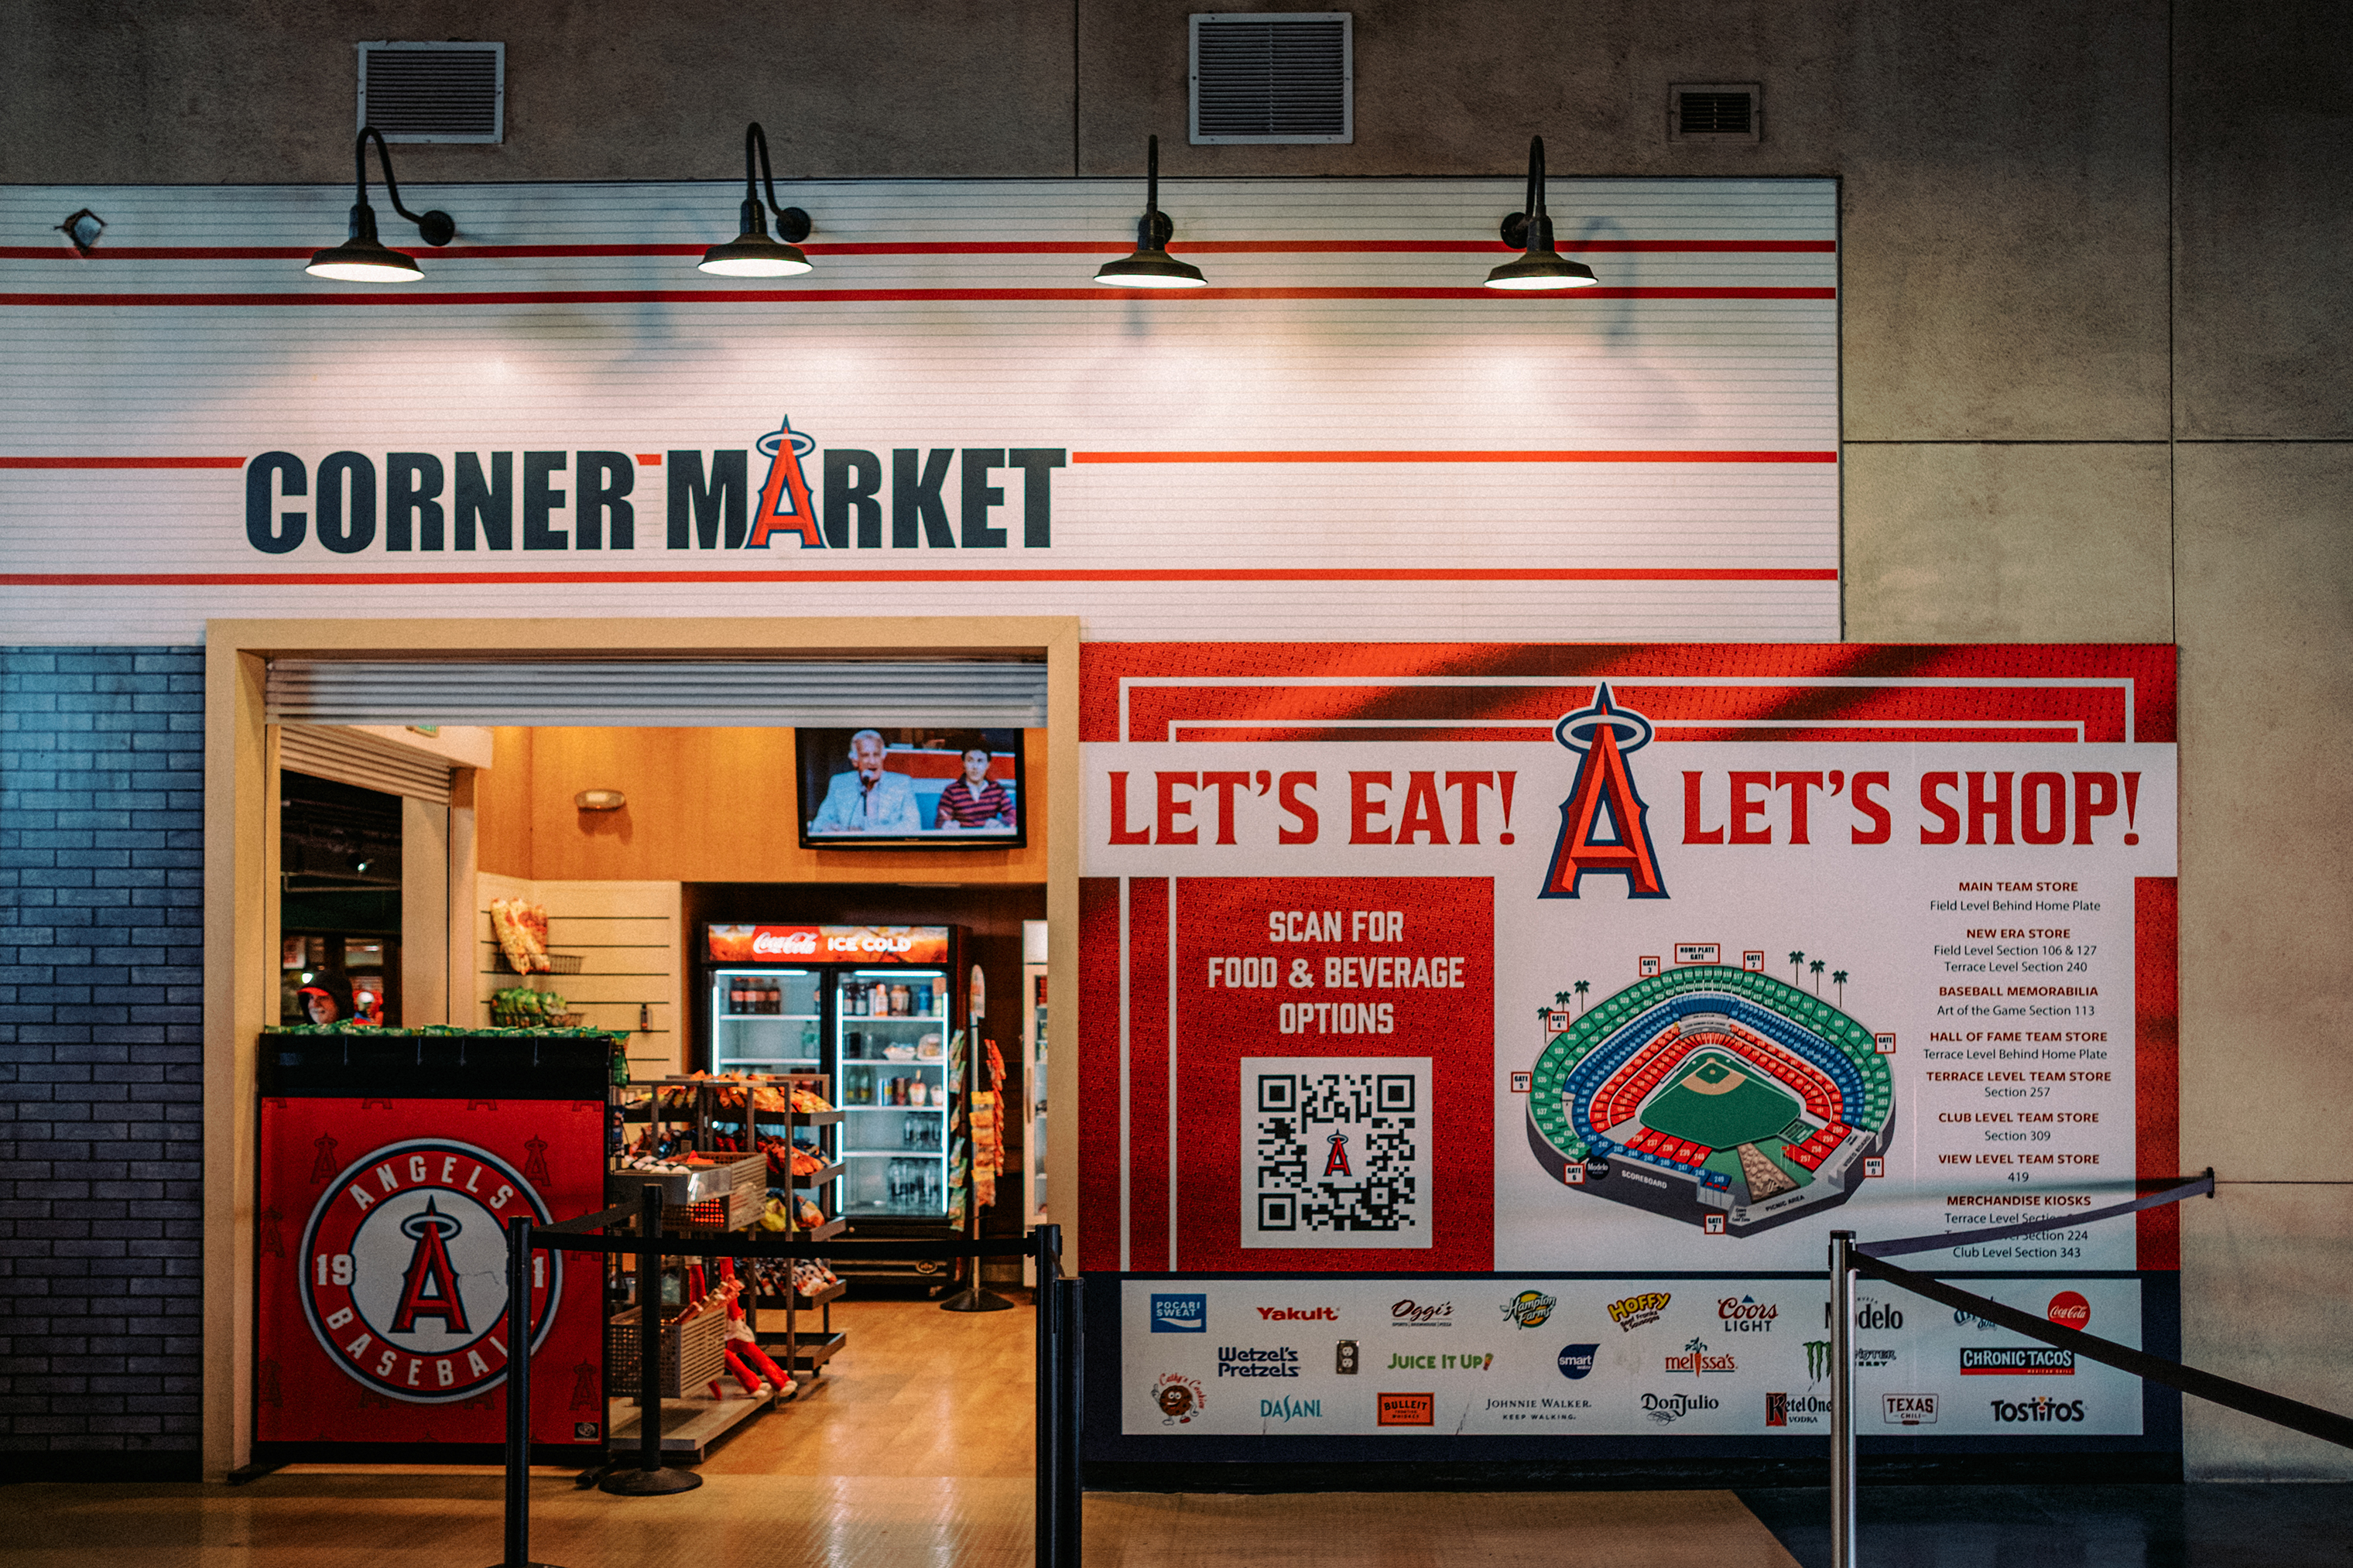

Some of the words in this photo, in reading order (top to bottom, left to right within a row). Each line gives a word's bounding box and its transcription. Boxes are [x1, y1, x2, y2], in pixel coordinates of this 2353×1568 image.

[245, 450, 635, 554] CORNER
[666, 414, 1067, 549] MARKET
[1537, 681, 1670, 899] A
[1108, 769, 1320, 846] LET'S
[1348, 769, 1518, 846] EAT!
[1681, 769, 1892, 845] LET'S
[1920, 770, 2142, 847] SHOP!
[1959, 882, 1993, 892] MAIN
[1997, 882, 2033, 892] TEAM
[2036, 882, 2078, 892] STORE
[1930, 900, 1957, 912] Field
[1961, 900, 1990, 912] Level
[1993, 900, 2033, 912] Behind
[2036, 900, 2070, 912] Home
[2073, 900, 2101, 912] Plate
[1269, 911, 1342, 942] SCAN
[1353, 911, 1404, 942] FOR
[1967, 929, 1997, 939] NEW
[2001, 929, 2026, 939] ERA
[2029, 929, 2070, 939] STORE
[827, 936, 858, 952] ICE
[861, 936, 912, 953] COLD
[1934, 945, 1961, 956] Field
[1964, 945, 1994, 956] Level
[1997, 945, 2038, 956] Section
[2043, 945, 2062, 956] 106
[2065, 945, 2074, 956] &
[2077, 945, 2097, 956] 127
[1208, 957, 1277, 988] FOOD
[1289, 957, 1314, 988] &
[1325, 957, 1464, 988] BEVERAGE
[1945, 961, 1986, 973] Terrace
[1989, 961, 2019, 973] Level
[2022, 961, 2064, 973] Section
[2067, 961, 2088, 973] 240
[1939, 987, 2003, 997] BASEBALL
[2008, 987, 2098, 997] MEMORABILIA
[1937, 1005, 1954, 1016] Art
[1957, 1005, 1969, 1016] of
[1971, 1005, 1990, 1016] the
[1993, 1005, 2026, 1016] Game
[2029, 1005, 2071, 1016] Section
[2075, 1005, 2095, 1016] 113
[1279, 1003, 1393, 1034] OPTIONS
[1930, 1032, 1962, 1042] HALL
[1966, 1032, 1984, 1042] OF
[1988, 1032, 2022, 1042] FAME
[2026, 1032, 2062, 1042] TEAM
[2065, 1032, 2108, 1042] STORE
[1924, 1049, 1964, 1060] Terrace
[1967, 1049, 1996, 1060] Level
[1999, 1049, 2039, 1060] Behind
[2042, 1049, 2077, 1060] Home
[2080, 1049, 2108, 1060] Plate
[1927, 1071, 1984, 1081] TERRACE
[1988, 1071, 2026, 1081] LEVEL
[2029, 1071, 2066, 1081] TEAM
[2070, 1071, 2112, 1081] STORE
[1985, 1087, 2026, 1097] Section
[2030, 1087, 2050, 1097] 257
[1939, 1113, 1971, 1122] CLUB
[1975, 1113, 2014, 1122] LEVEL
[2017, 1113, 2053, 1122] TEAM
[2057, 1113, 2099, 1122] STORE
[1985, 1130, 2026, 1142] Section
[2030, 1130, 2051, 1142] 309
[1939, 1155, 1971, 1164] VIEW
[1975, 1155, 2014, 1164] LEVEL
[2018, 1155, 2054, 1164] TEAM
[2058, 1155, 2100, 1164] STORE
[349, 1155, 514, 1210] ANGELS
[1622, 1169, 1667, 1189] SCOREBOARD
[2008, 1172, 2029, 1183] 419
[1947, 1196, 2041, 1206] MERCHANDISE
[2044, 1196, 2091, 1206] KIOSKS
[1945, 1213, 1986, 1224] Terrace
[1990, 1213, 2019, 1224] Level
[2067, 1231, 2088, 1241] 224
[1953, 1247, 1980, 1258] Club
[1983, 1247, 2012, 1258] Level
[2016, 1247, 2057, 1258] Section
[2060, 1247, 2081, 1258] 343
[317, 1254, 354, 1286] 19
[1156, 1301, 1200, 1310] POCARI
[1391, 1299, 1455, 1322] Oggi's
[1502, 1294, 1557, 1322] Hampton
[1608, 1292, 1671, 1323] HOFFY
[1718, 1297, 1779, 1320] Coors
[1257, 1306, 1339, 1321] Yakult
[1518, 1306, 1553, 1330] Farms
[1725, 1320, 1772, 1333] LIGHT
[1218, 1347, 1298, 1362] Wetzel's
[1388, 1353, 1436, 1369] JUICE
[1441, 1354, 1456, 1369] IT
[1559, 1355, 1592, 1365] smart
[1963, 1350, 2026, 1367] CHRONIC
[2027, 1350, 2072, 1367] TACOS
[1218, 1362, 1300, 1378] Pretzels
[1665, 1353, 1736, 1377] melissa's
[1260, 1395, 1321, 1422] DASANI
[1384, 1400, 1428, 1411] BULLEIT
[1485, 1398, 1537, 1410] JOHNNIE
[1766, 1394, 1806, 1425] Ketel
[1886, 1398, 1934, 1414] TEXAS
